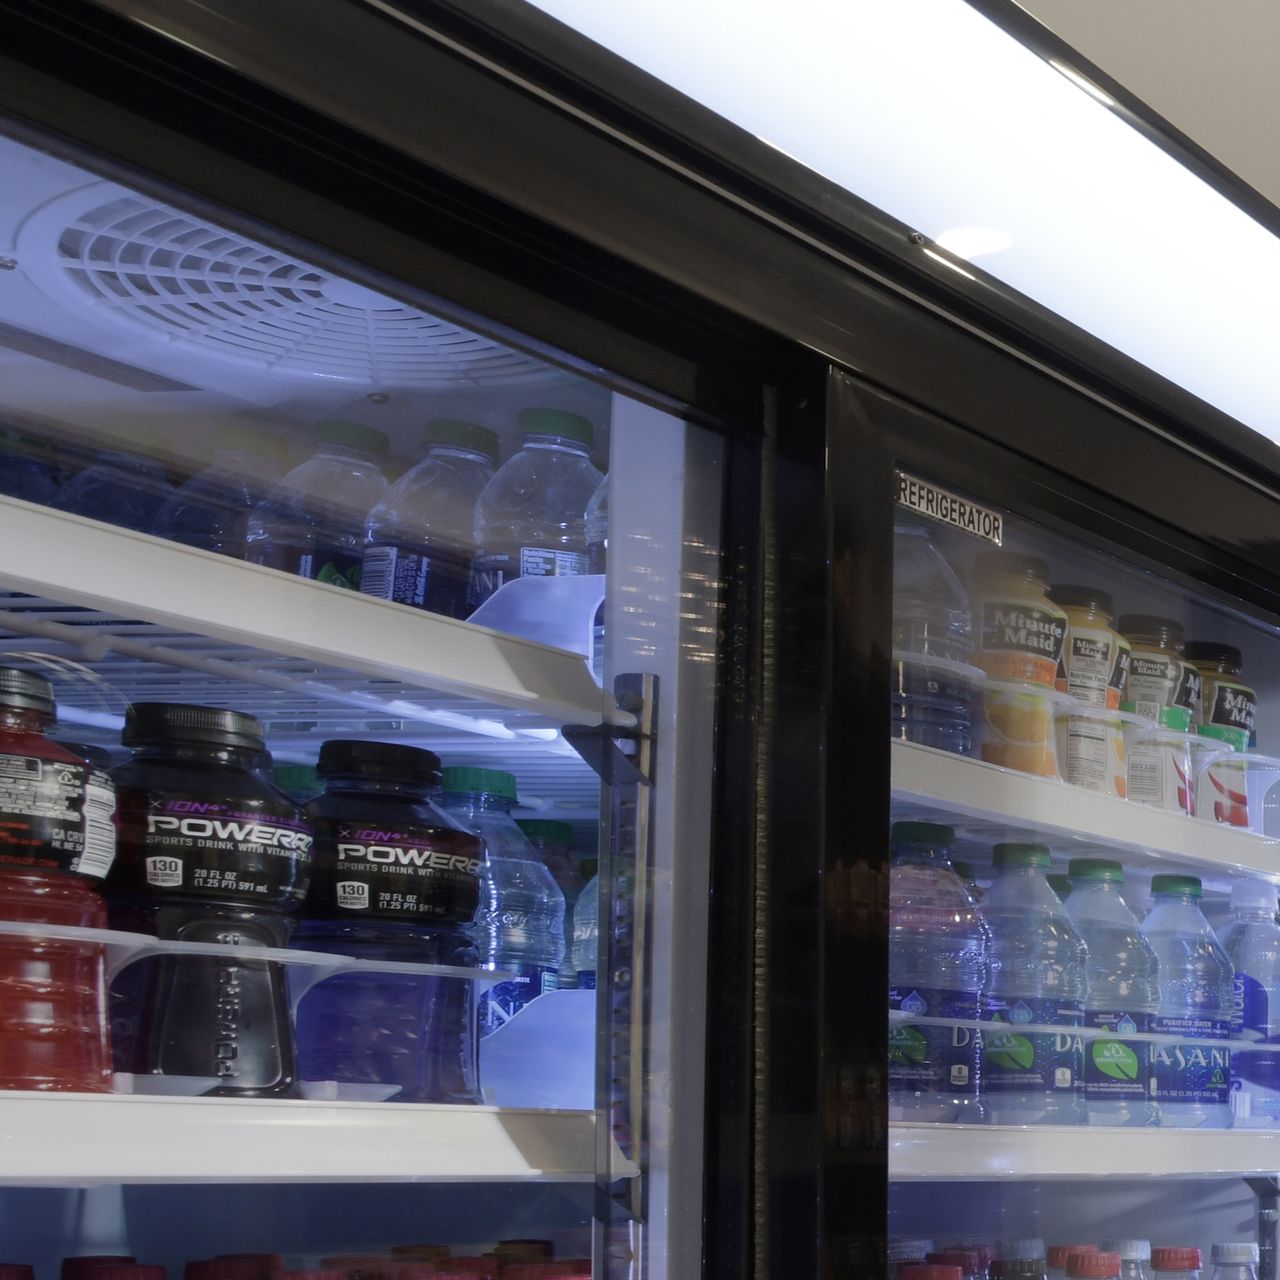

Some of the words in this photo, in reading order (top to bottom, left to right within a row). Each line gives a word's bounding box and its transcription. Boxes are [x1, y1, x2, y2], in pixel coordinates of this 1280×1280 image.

[899, 478, 1001, 540] REFRIGERATOR
[994, 608, 1062, 638] Minute
[1004, 628, 1056, 651] Maid
[53, 828, 65, 840] CA
[146, 836, 193, 846] SPORTS
[197, 840, 234, 851] DRINK
[238, 842, 264, 854] WITH
[151, 859, 178, 873] 130
[337, 861, 378, 871] SPORTS
[382, 865, 414, 875] DRINK
[194, 869, 207, 878] 20
[210, 870, 222, 879] FL
[225, 872, 237, 880] OZ
[194, 879, 219, 889] (1.25
[221, 881, 236, 891] PT)
[238, 883, 254, 891] 591
[340, 885, 365, 896] 130
[379, 893, 390, 901] 20
[393, 893, 403, 901] FL
[406, 895, 417, 903] OZ
[379, 902, 401, 911] (1.25
[403, 903, 417, 912] PT)
